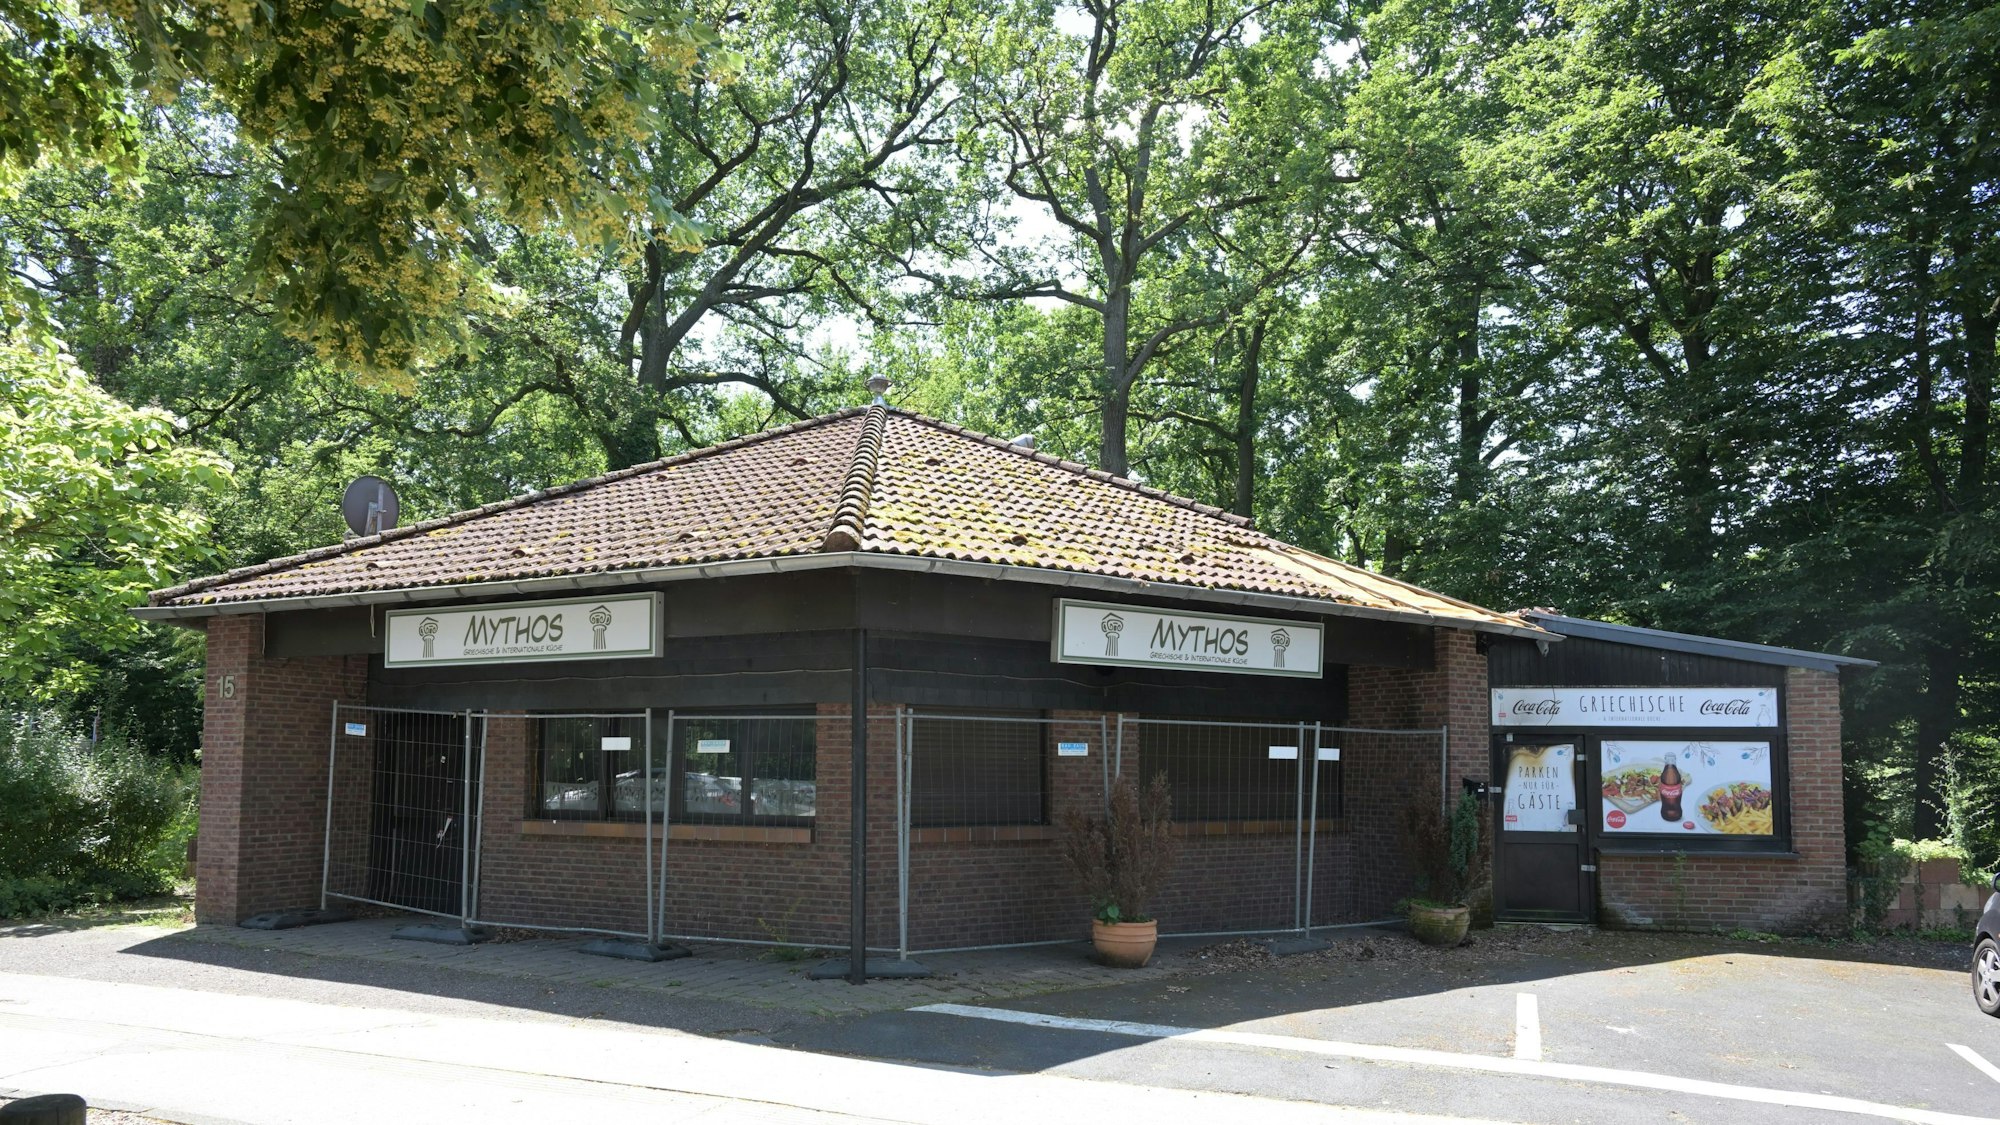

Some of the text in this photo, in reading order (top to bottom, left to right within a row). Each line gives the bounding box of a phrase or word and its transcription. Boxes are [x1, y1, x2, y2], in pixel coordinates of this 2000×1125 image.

[464, 613, 563, 646] MYTHOS
[1150, 618, 1249, 656] MYTHOS
[464, 648, 495, 656] GRIECHISCHE
[502, 645, 545, 654] INTERNATIONALE
[1149, 651, 1183, 660] GRIECHISCHE
[1191, 653, 1232, 664] INTERNATIONALE
[216, 675, 235, 698] 15
[1512, 695, 1752, 716] Coca-Cola GRIECHISCHE Coca-Cola
[1518, 766, 1558, 778] PARKEN
[1517, 791, 1561, 810] GÄSTE
